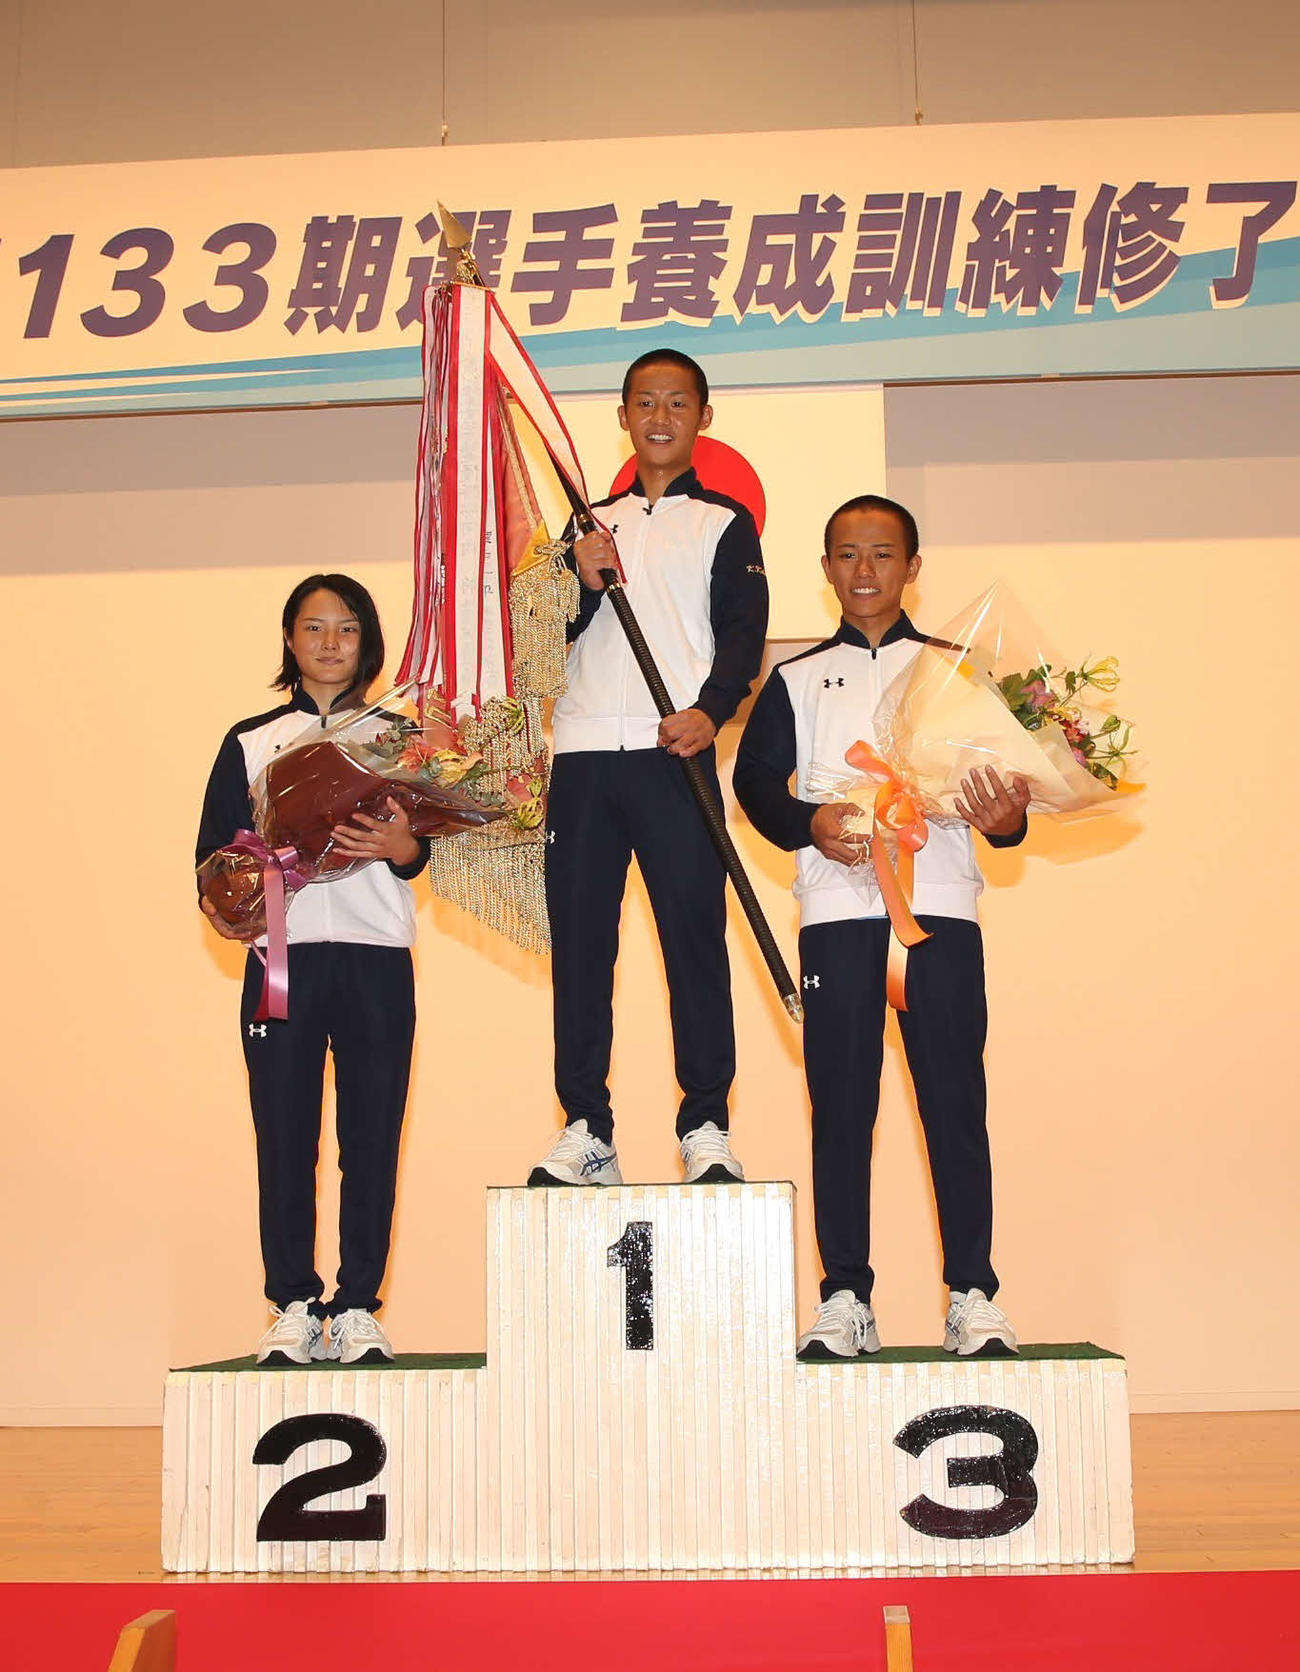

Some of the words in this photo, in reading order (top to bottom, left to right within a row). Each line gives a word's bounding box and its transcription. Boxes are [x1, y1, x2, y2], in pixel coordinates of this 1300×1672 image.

[18, 180, 1298, 339] 133期選手養成訓練修了
[607, 1221, 653, 1351] 1
[253, 1413, 387, 1542] 2
[892, 1404, 1039, 1540] 3
